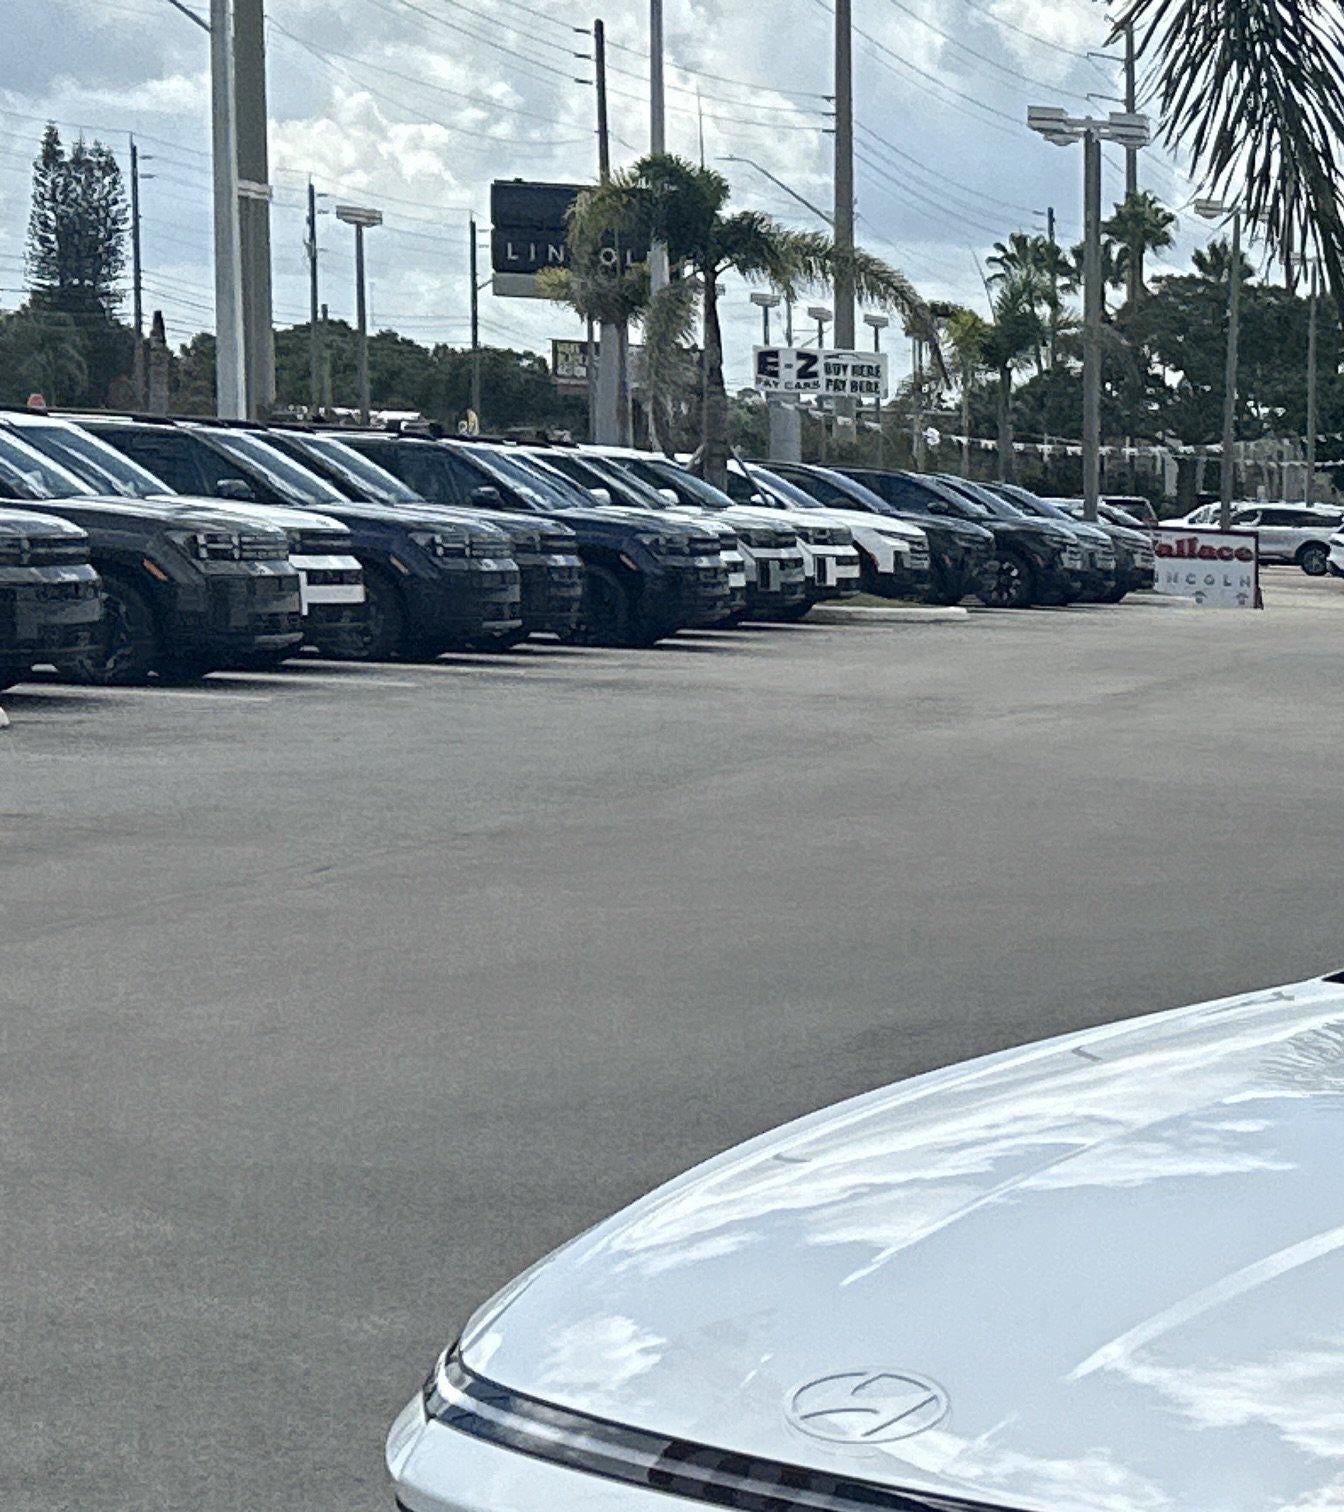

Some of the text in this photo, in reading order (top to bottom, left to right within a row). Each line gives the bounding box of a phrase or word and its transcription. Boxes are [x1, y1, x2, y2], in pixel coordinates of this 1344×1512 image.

[506, 242, 652, 264] LINOL
[757, 350, 819, 379] E-Z
[825, 378, 847, 392] PAY
[1153, 537, 1254, 562] allace
